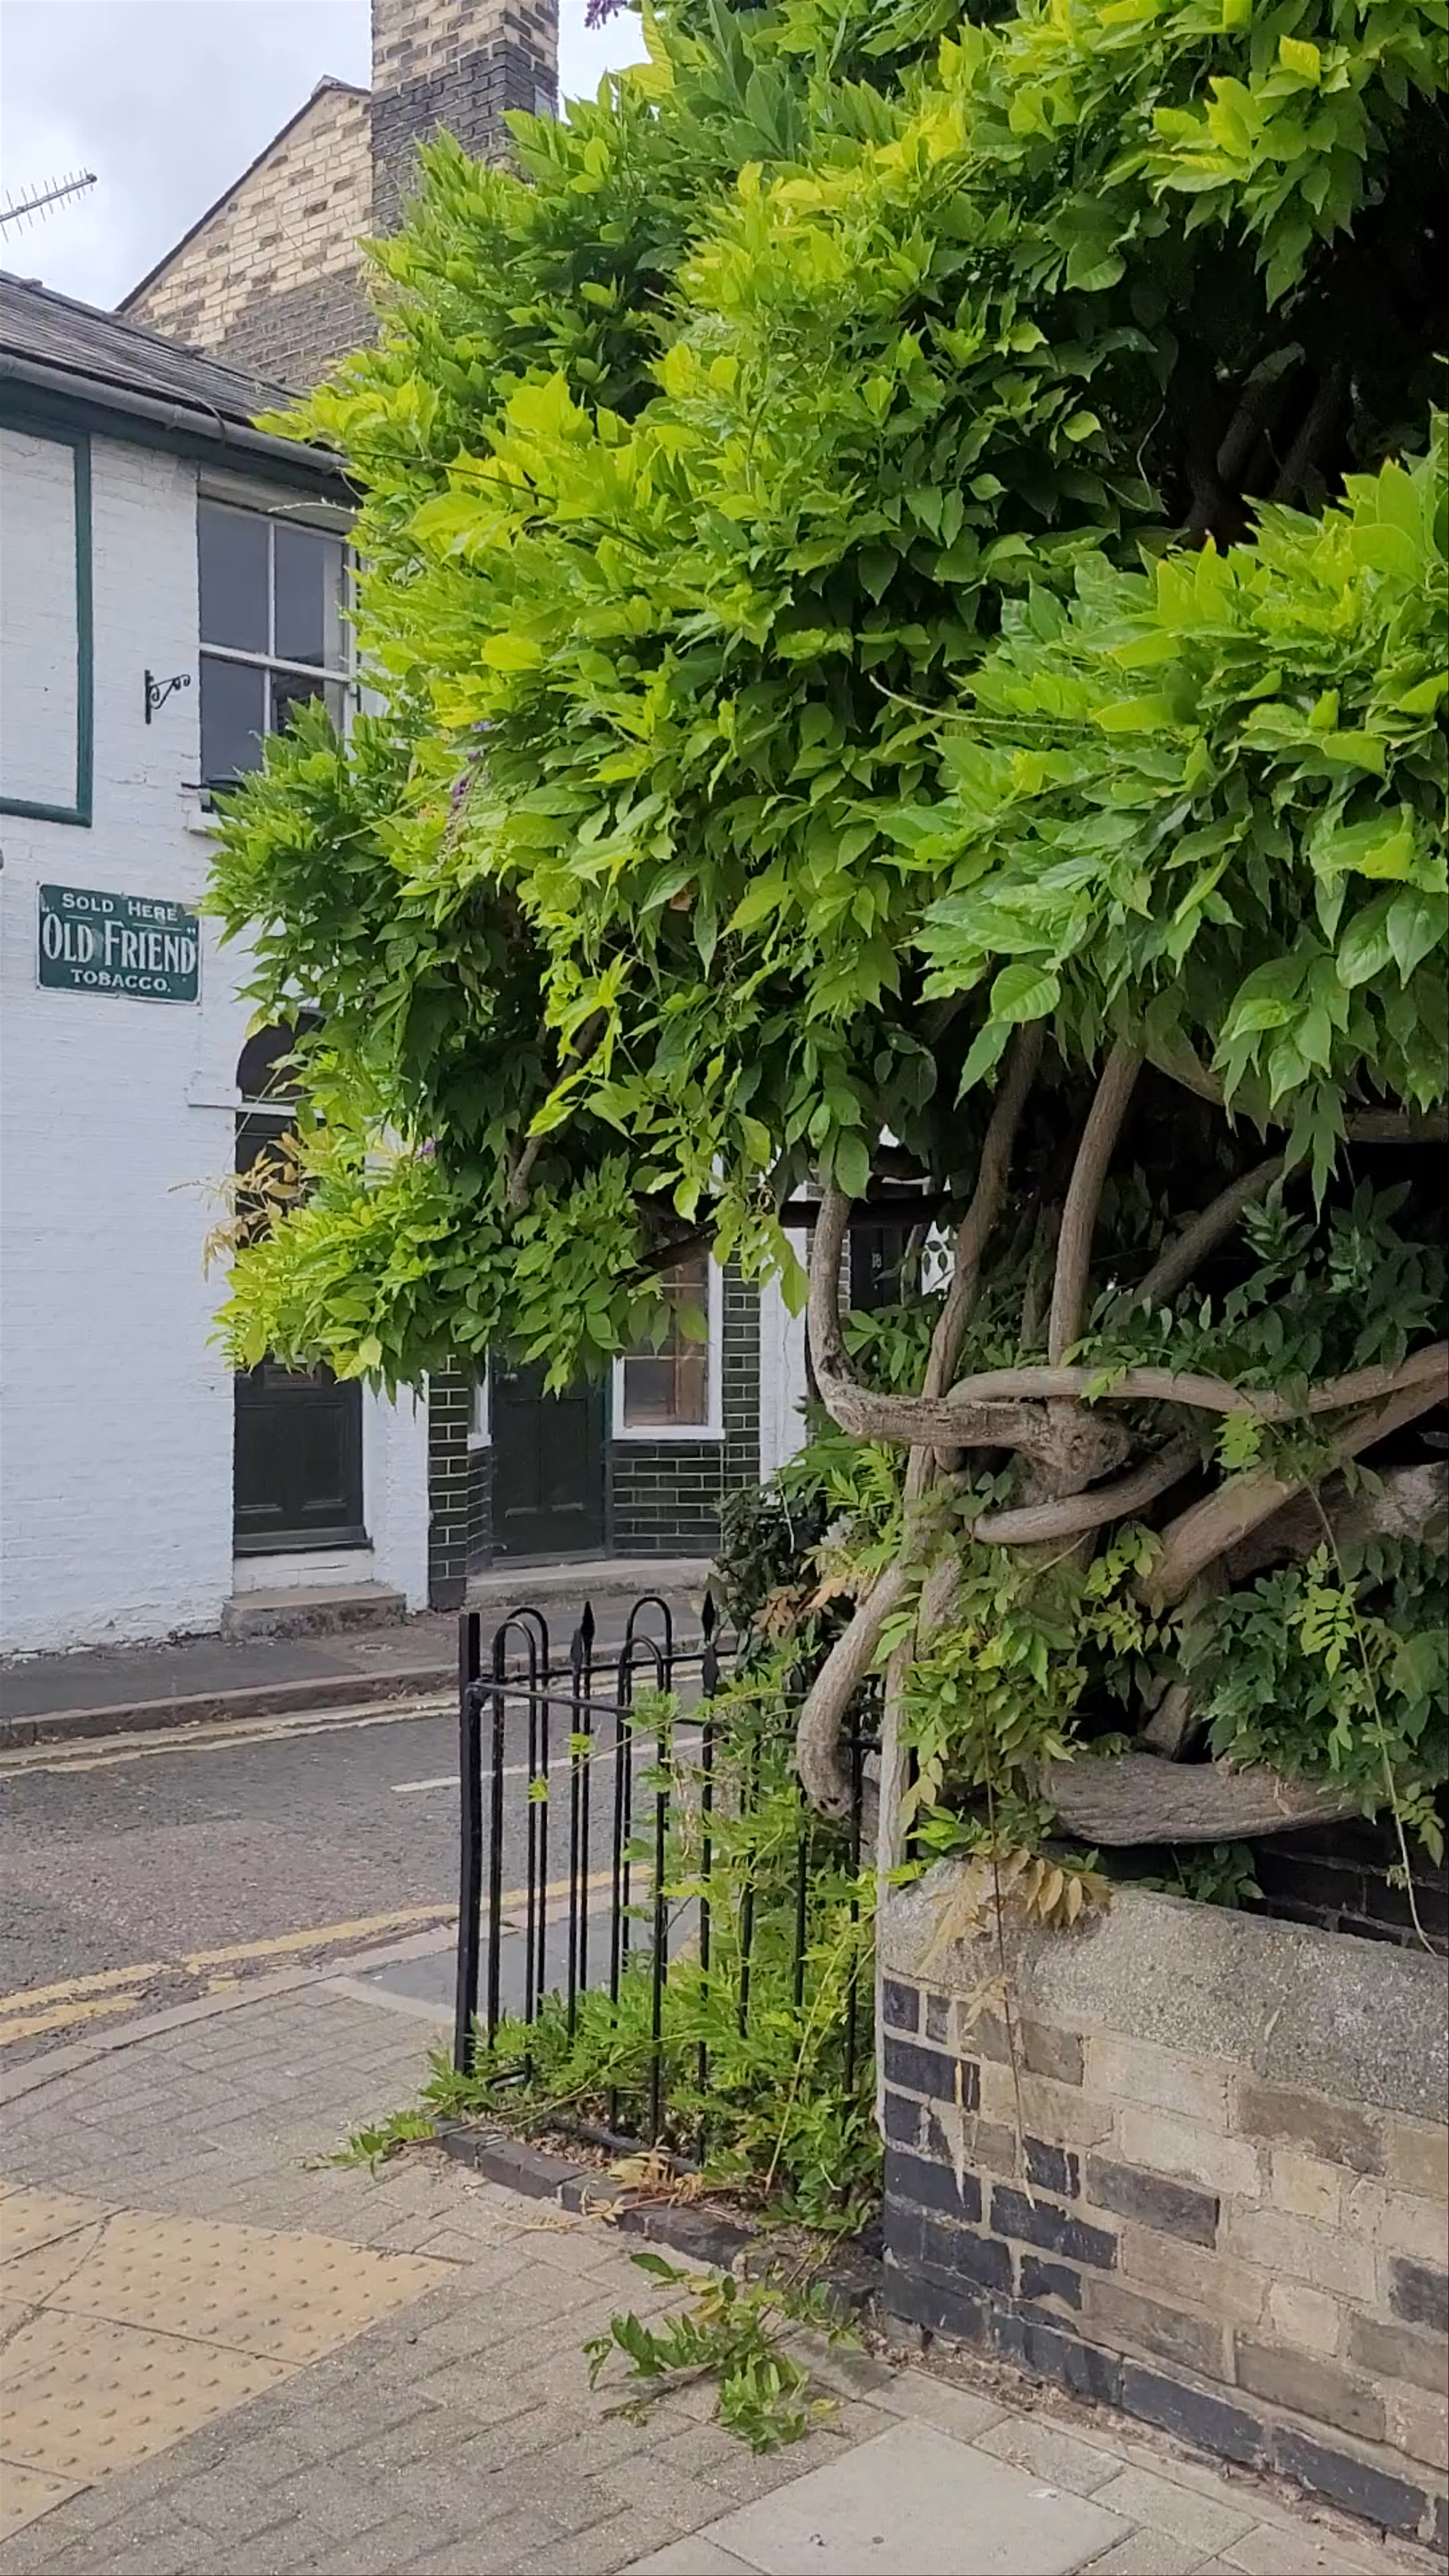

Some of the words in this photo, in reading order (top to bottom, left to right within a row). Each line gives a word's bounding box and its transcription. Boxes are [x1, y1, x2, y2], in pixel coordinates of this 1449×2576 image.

[62, 893, 114, 912] SOLD
[128, 901, 178, 921] HERE
[71, 969, 171, 992] TOBACCO.
[871, 1253, 882, 1269] 18
